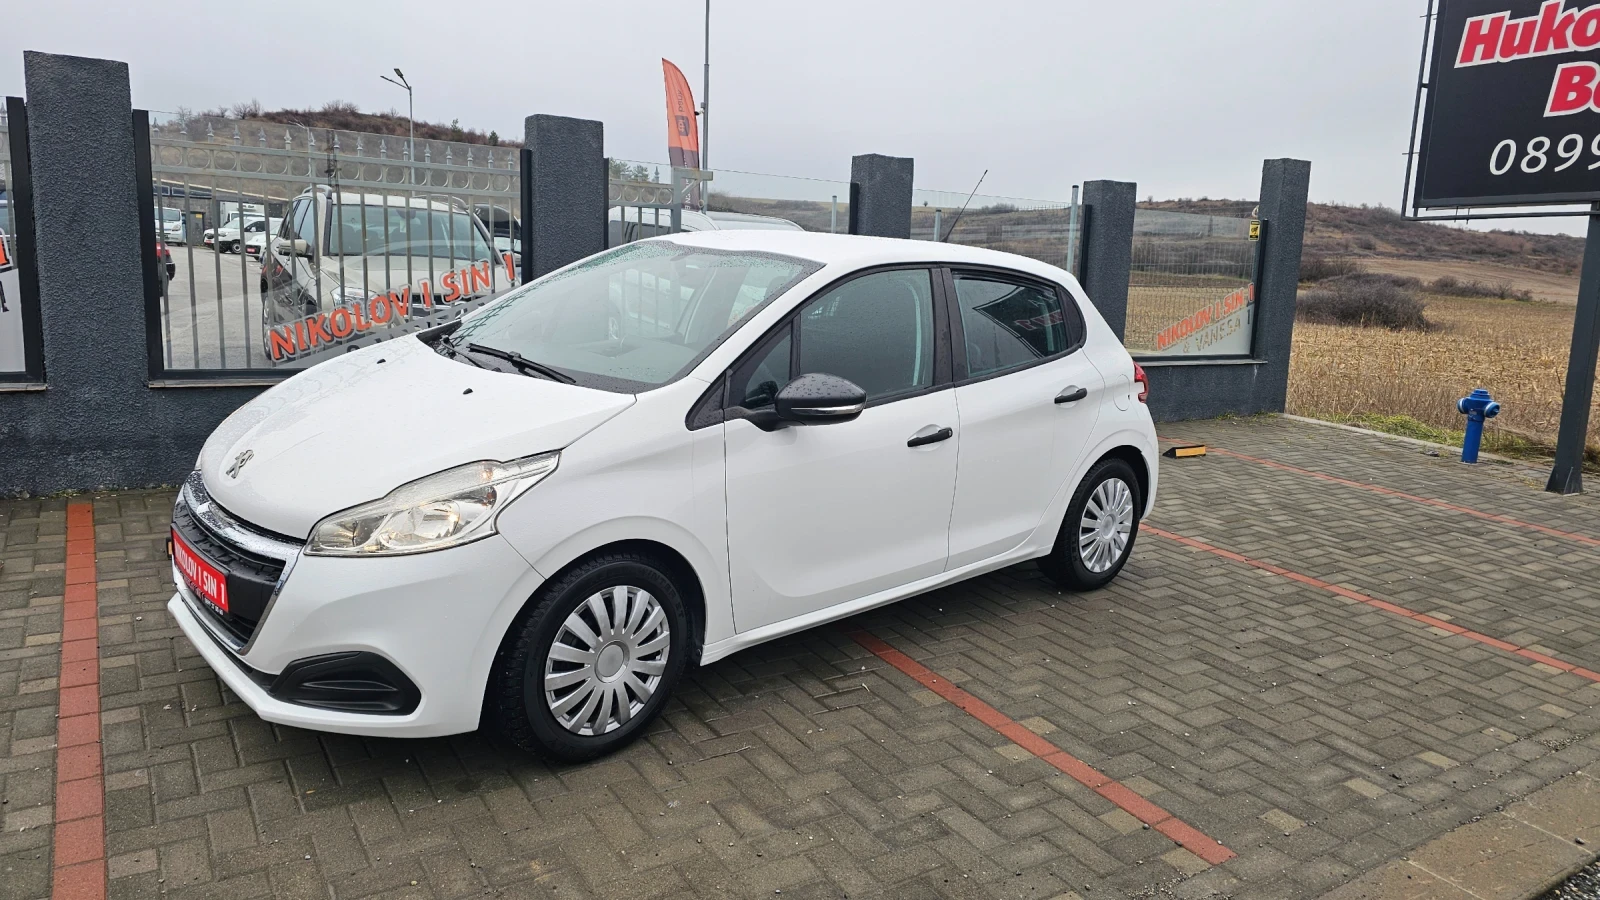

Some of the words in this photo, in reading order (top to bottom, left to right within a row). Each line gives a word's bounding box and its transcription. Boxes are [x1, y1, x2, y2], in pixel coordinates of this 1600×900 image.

[1544, 62, 1600, 116] В
[268, 285, 411, 362] NIKOLOV
[420, 280, 433, 310] I
[442, 260, 492, 302] SIN
[502, 252, 516, 281] 1
[1157, 304, 1213, 350] NIKOLOV
[1215, 301, 1220, 319] I
[1224, 288, 1244, 315] SIN
[1196, 318, 1241, 350] VANESA
[174, 538, 197, 580] NIKOLOV
[203, 571, 217, 598] SIN
